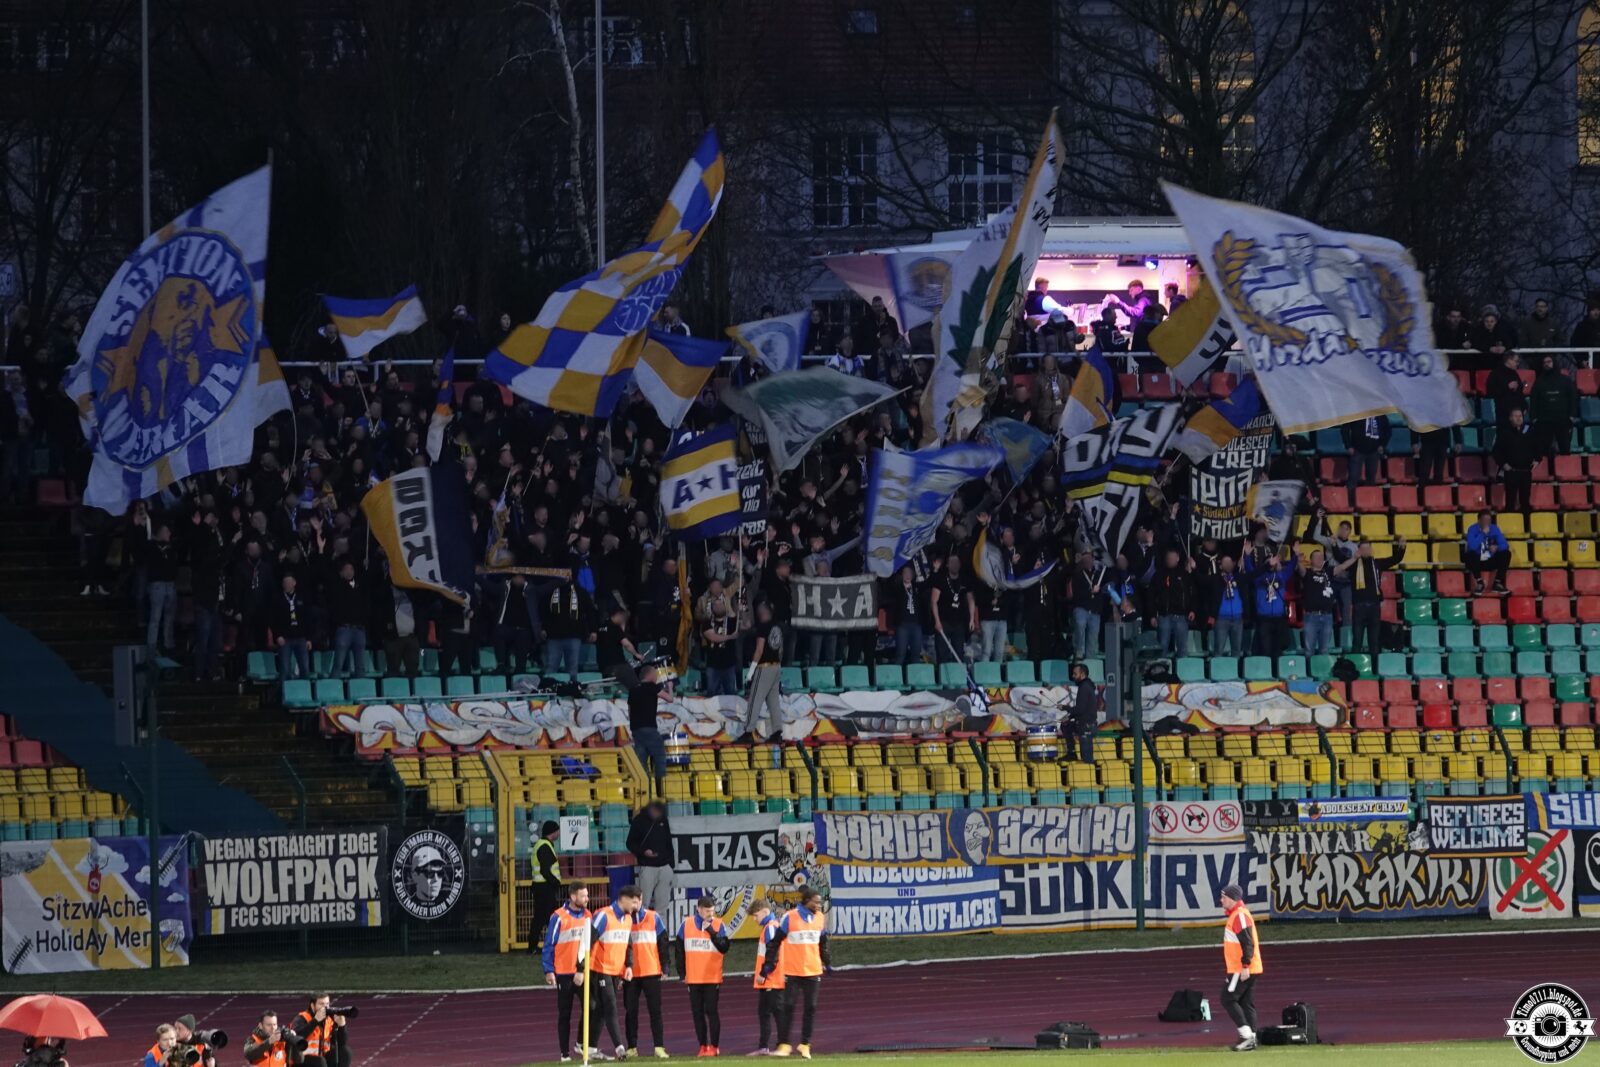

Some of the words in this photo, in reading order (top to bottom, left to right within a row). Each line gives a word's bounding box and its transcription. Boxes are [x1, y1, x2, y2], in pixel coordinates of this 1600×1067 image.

[109, 236, 243, 335] SEKTION
[1320, 803, 1375, 815] ADOLESCENT
[1376, 802, 1405, 813] CREW
[1430, 802, 1525, 827] REFUGEES
[1549, 792, 1600, 827] SÜ
[204, 838, 255, 861] VEGAN
[258, 834, 336, 859] STRAIGHT
[338, 832, 378, 856] EDGE
[434, 834, 449, 848] MIT
[446, 845, 460, 864] UNS
[672, 832, 776, 873] LTRAS
[1249, 829, 1373, 855] WEIMAR
[1431, 826, 1525, 850] WELCOME
[204, 856, 381, 907] WOLFPACK
[897, 888, 916, 897] UND
[1000, 852, 1268, 916] SÜDKURVE
[1273, 851, 1481, 907] HARAKIRI
[42, 895, 148, 921] SitzwAche
[231, 907, 259, 927] FCC
[262, 902, 356, 926] SUPPORTERS
[830, 896, 998, 935] UNVERKÄUFLICH
[36, 925, 108, 955] HolidAy
